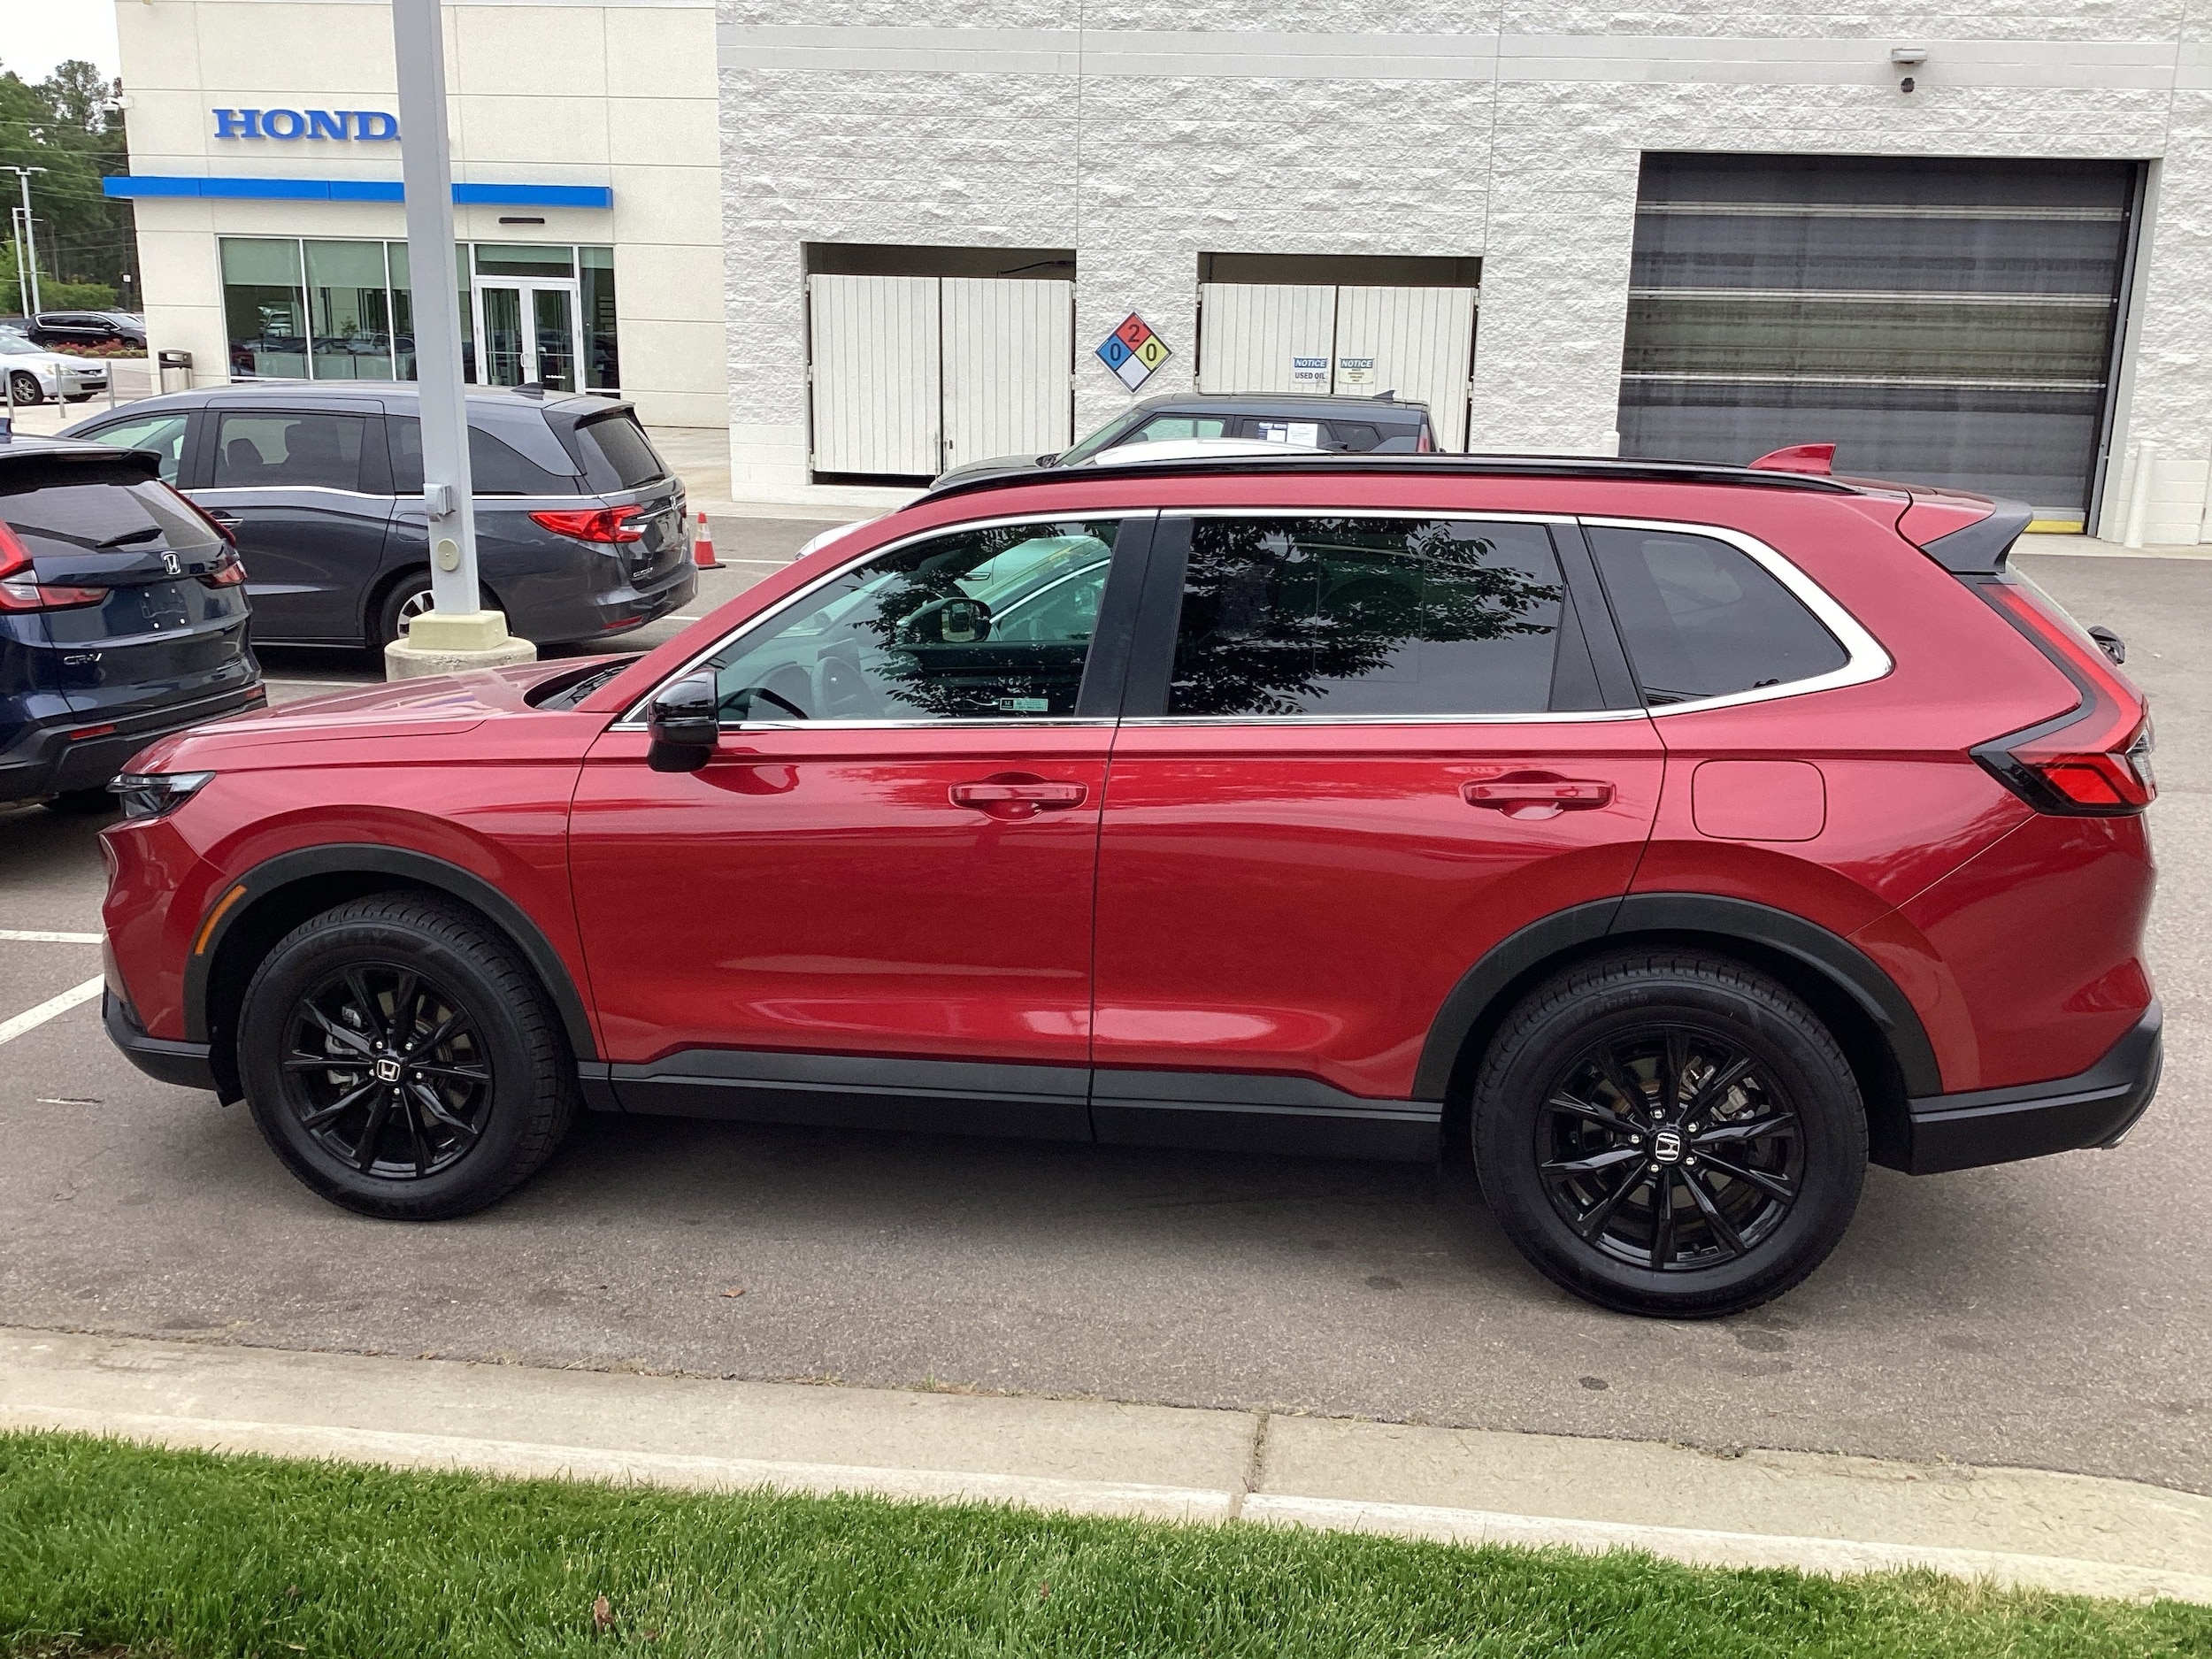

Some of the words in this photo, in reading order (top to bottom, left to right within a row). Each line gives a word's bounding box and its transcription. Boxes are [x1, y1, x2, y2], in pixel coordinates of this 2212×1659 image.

[211, 109, 401, 141] HOND
[1127, 324, 1140, 342] 2
[1110, 342, 1121, 361] 0
[1146, 343, 1157, 362] 0
